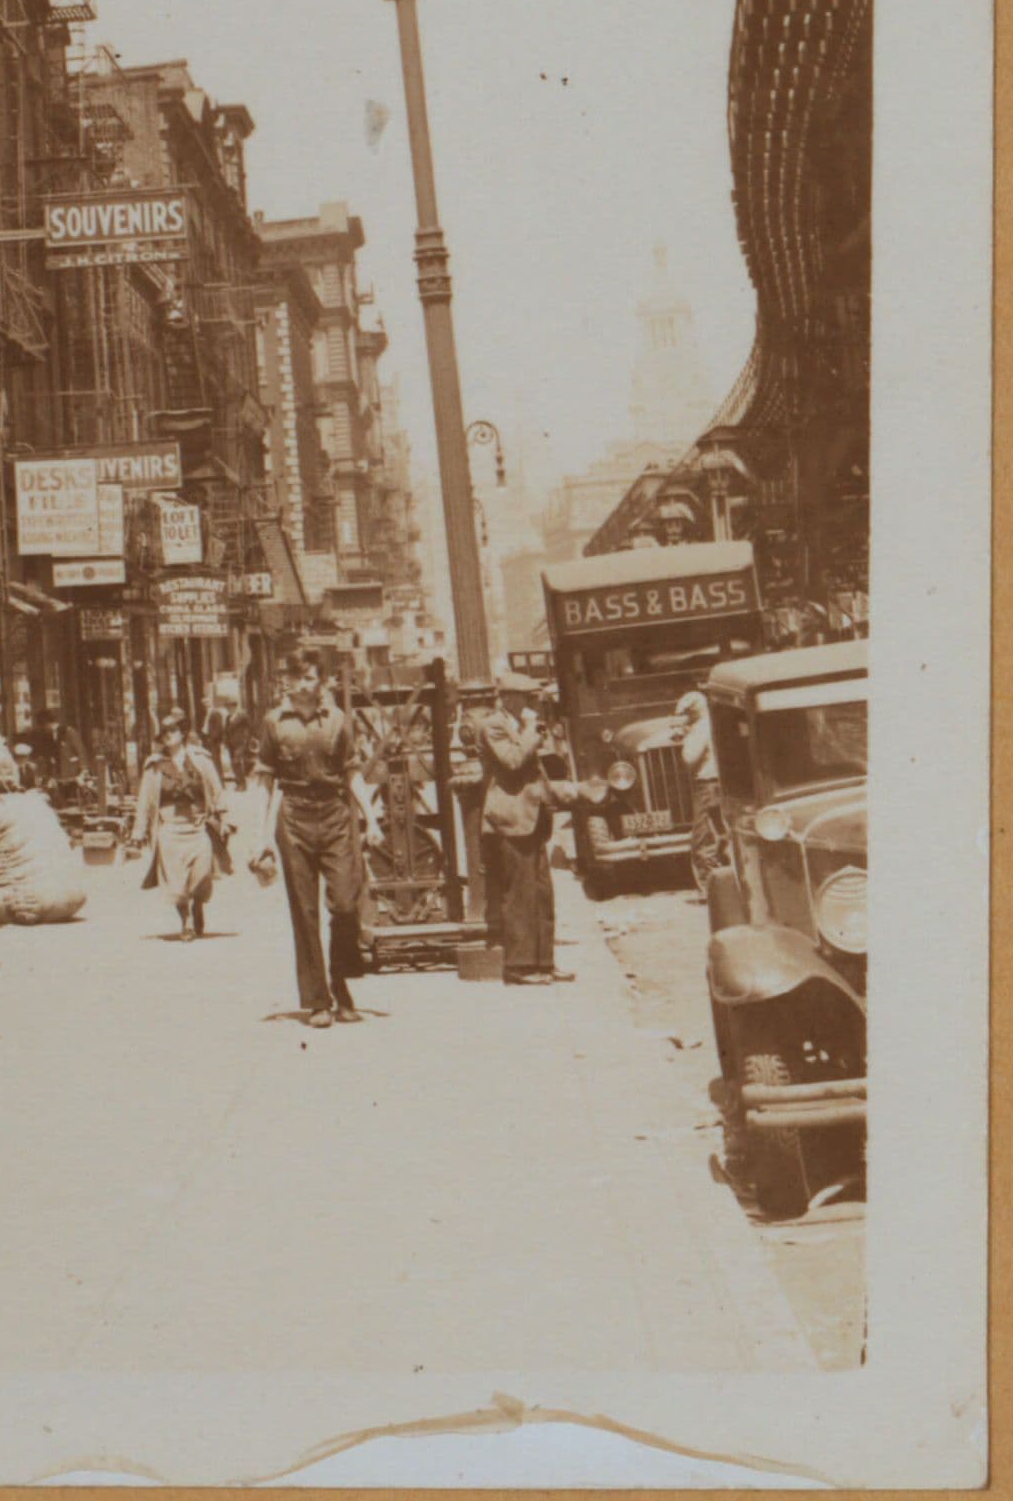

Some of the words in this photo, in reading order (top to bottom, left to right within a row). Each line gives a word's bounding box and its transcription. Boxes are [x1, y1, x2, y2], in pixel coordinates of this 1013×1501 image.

[50, 200, 183, 239] SOUVENIRS
[20, 466, 93, 491] DESKS
[162, 509, 195, 525] LOFT
[164, 525, 177, 540] TO
[564, 591, 639, 625] BASS
[646, 589, 663, 616] &
[669, 580, 746, 613] BASS
